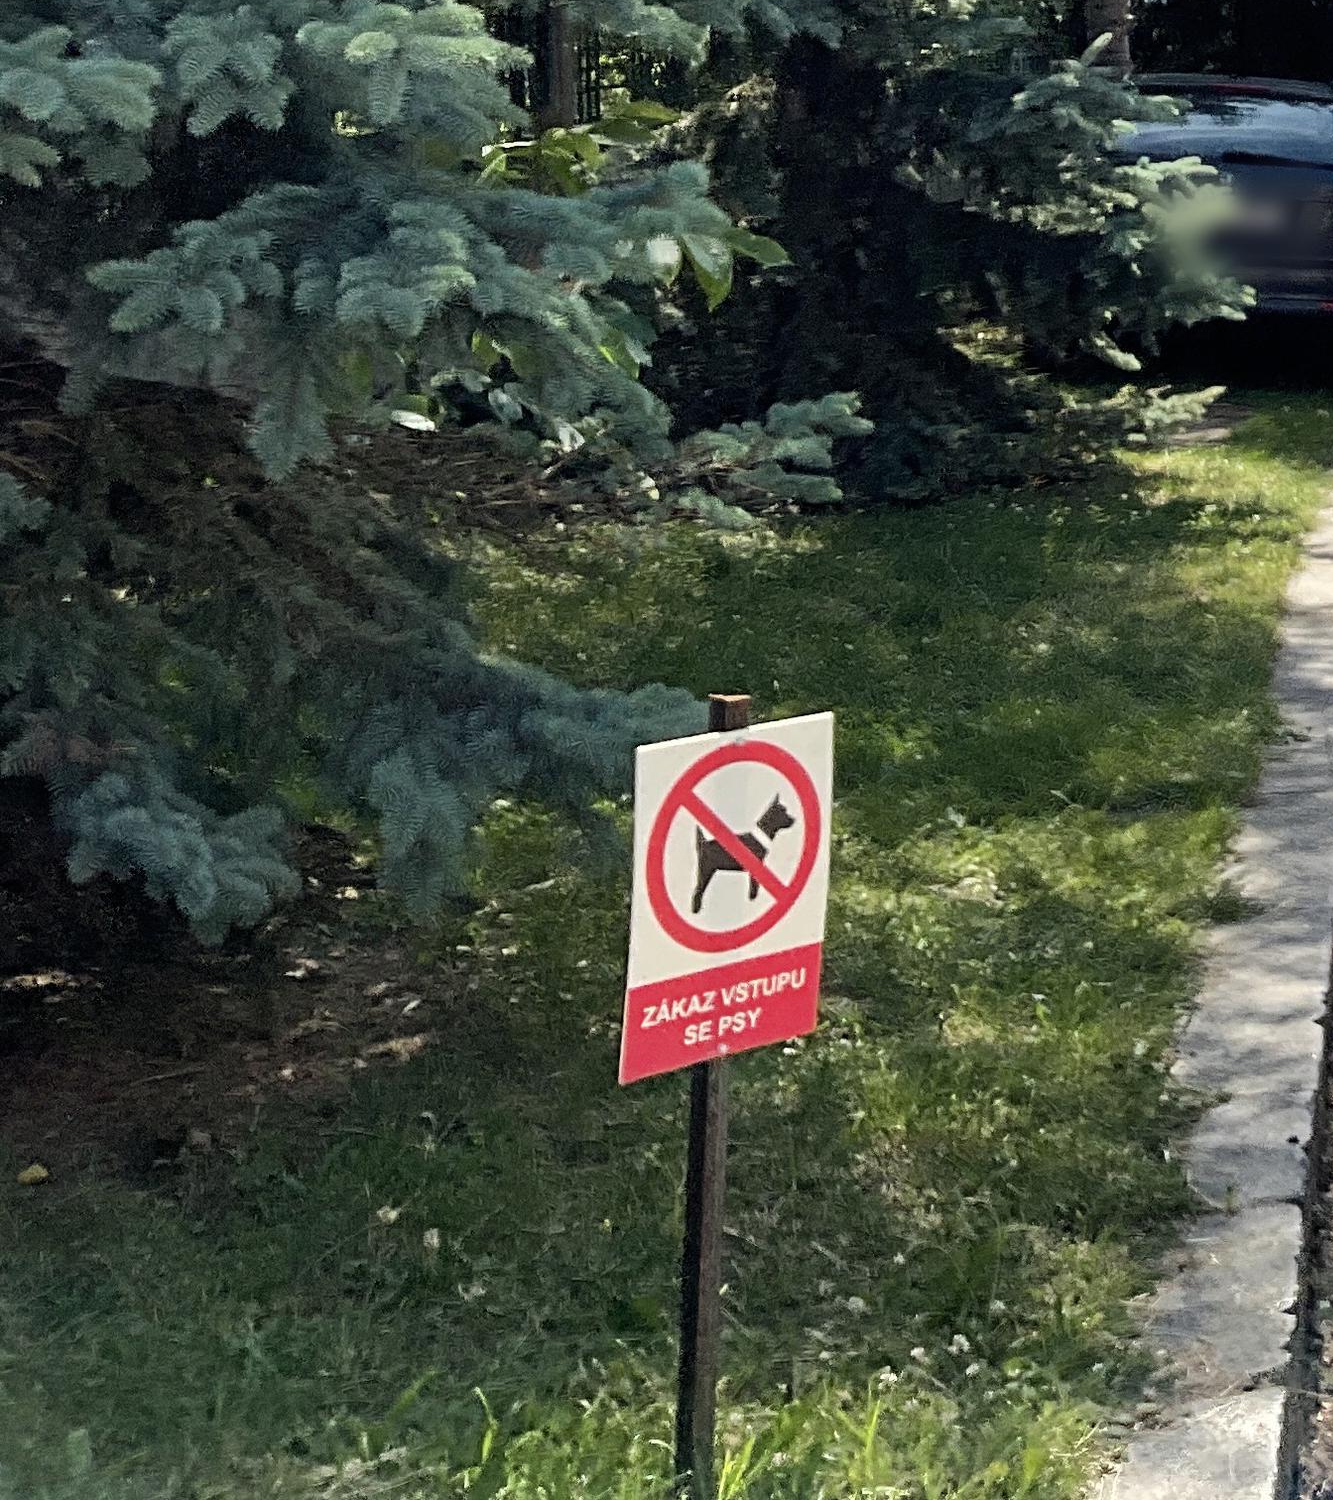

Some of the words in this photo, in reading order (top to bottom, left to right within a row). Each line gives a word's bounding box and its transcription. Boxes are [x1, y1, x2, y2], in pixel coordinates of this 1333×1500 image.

[640, 991, 717, 1028] ZÁKAZ
[720, 967, 807, 1006] VSTUPU
[684, 1020, 713, 1045] SE
[718, 1006, 762, 1037] PSY
